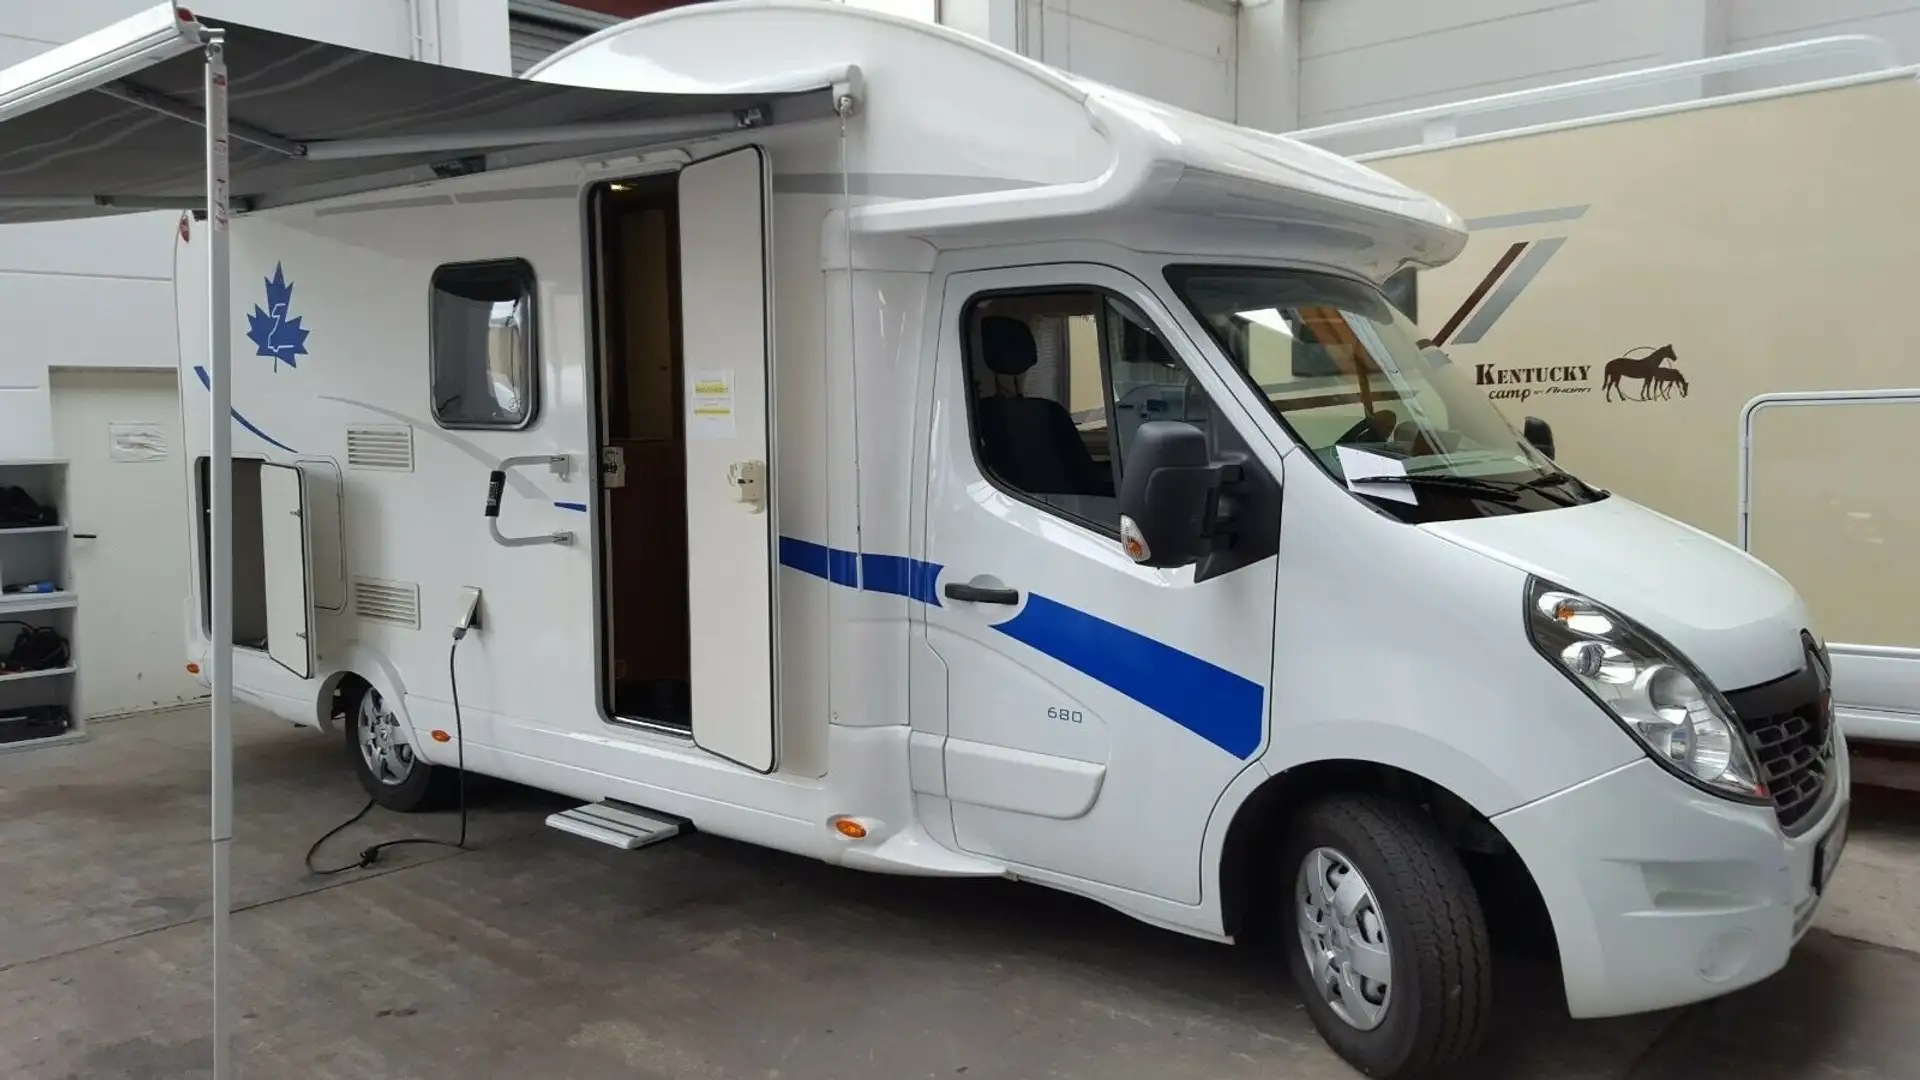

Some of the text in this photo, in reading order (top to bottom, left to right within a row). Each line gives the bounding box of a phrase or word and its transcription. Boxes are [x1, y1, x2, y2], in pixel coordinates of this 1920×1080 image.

[1475, 364, 1591, 385] KENTUCKY
[1488, 388, 1531, 402] camp
[1047, 706, 1083, 724] 680
